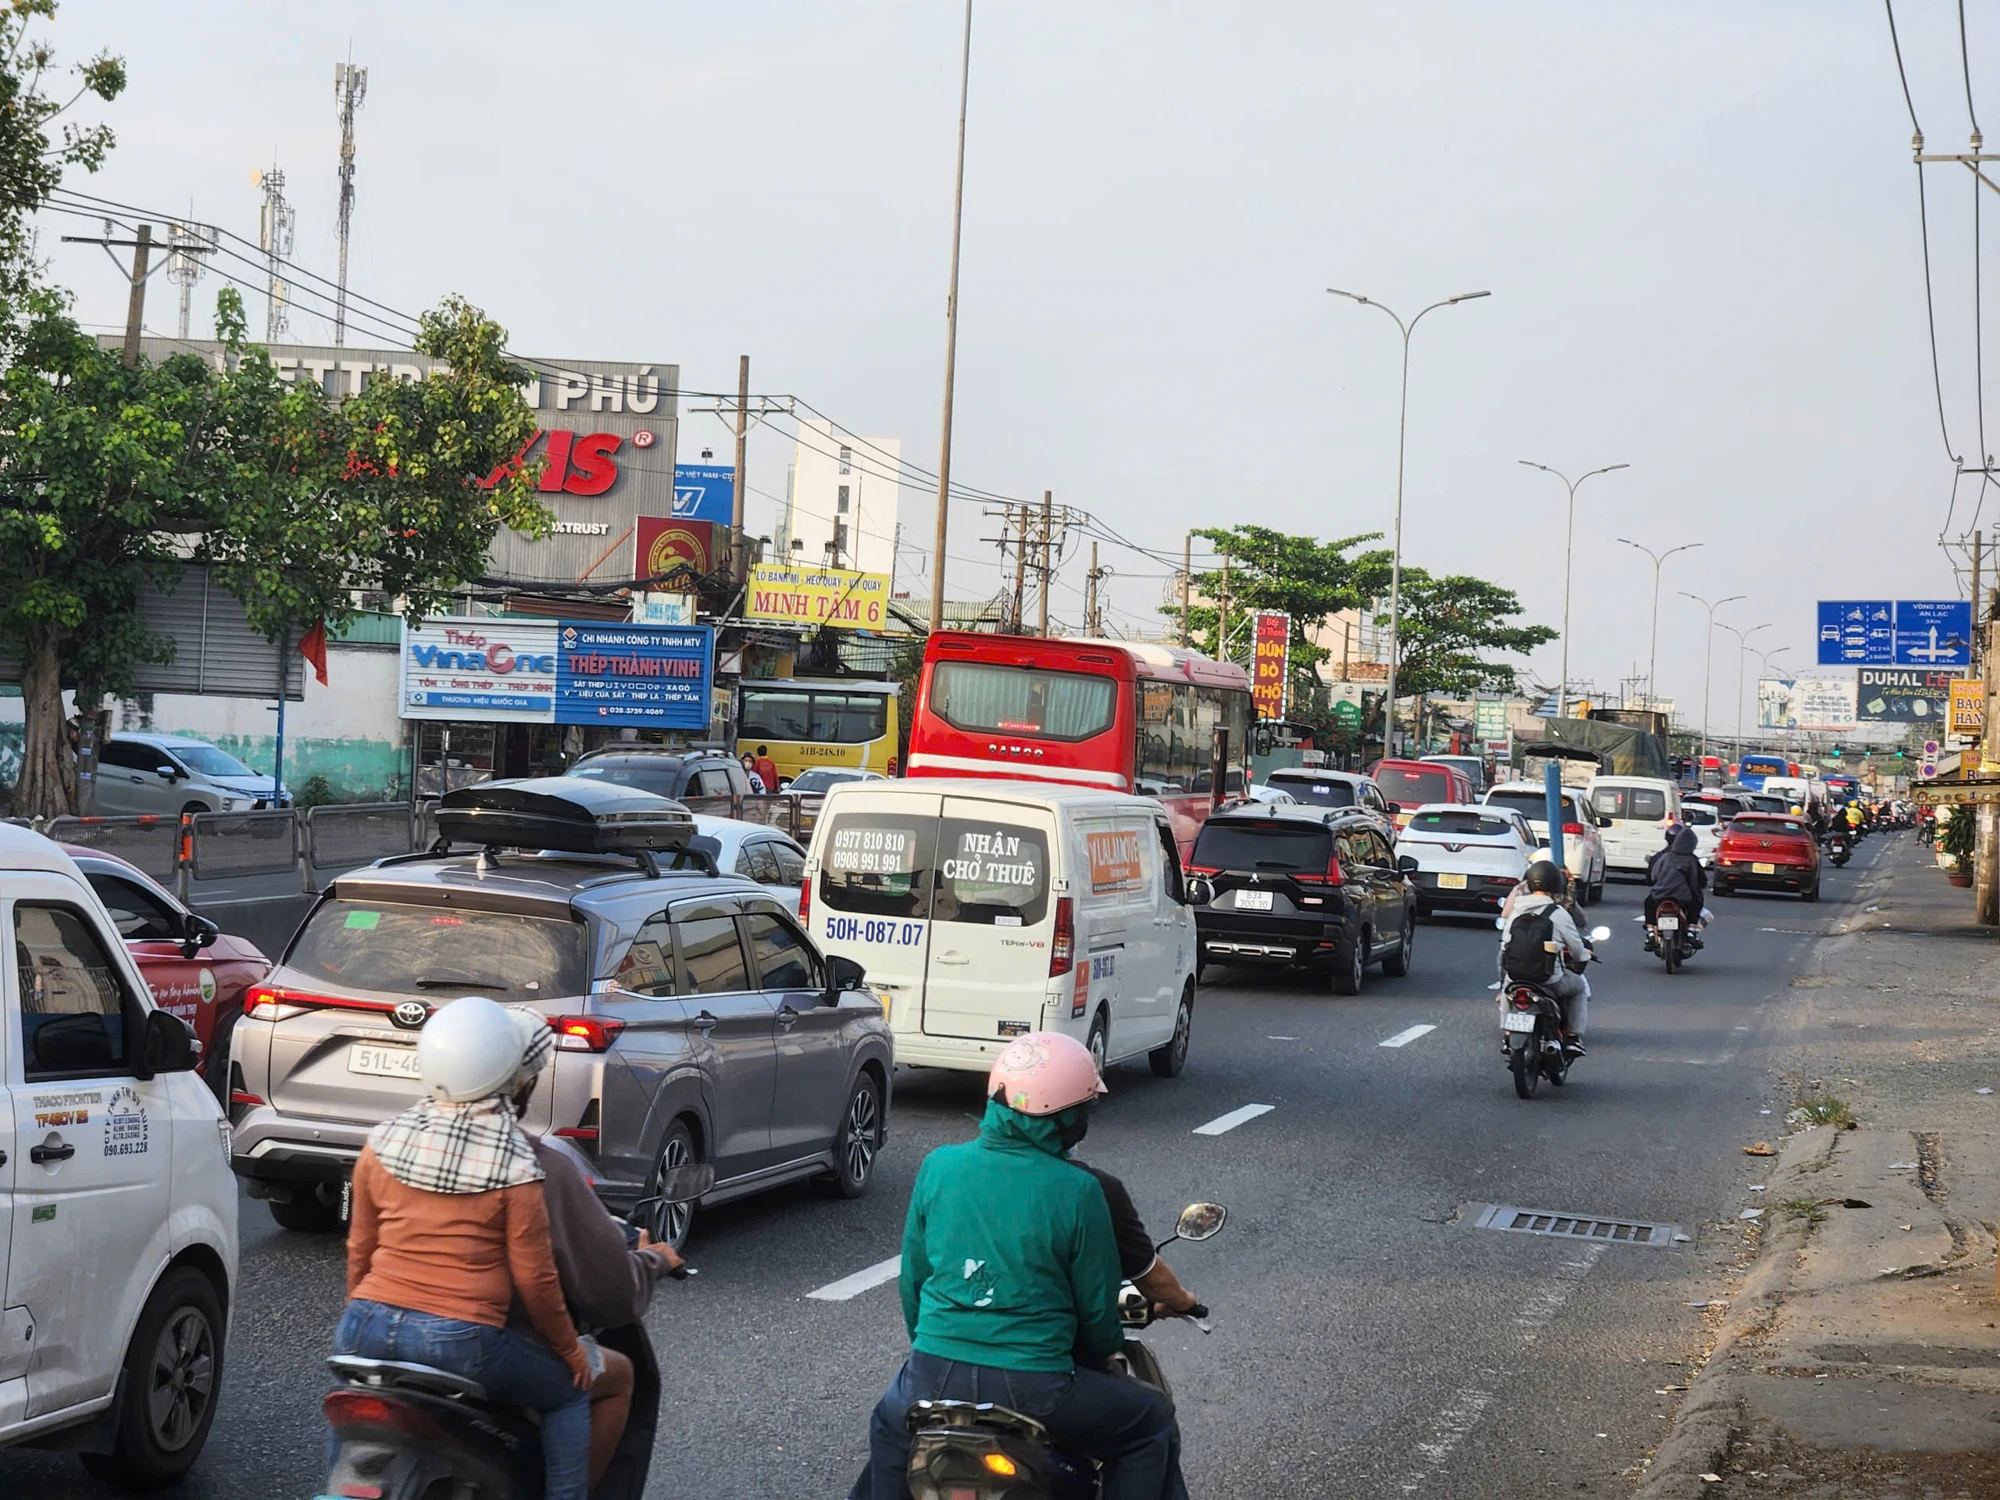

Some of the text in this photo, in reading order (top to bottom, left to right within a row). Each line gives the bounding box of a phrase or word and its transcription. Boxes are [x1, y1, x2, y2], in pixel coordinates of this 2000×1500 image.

[557, 366, 660, 414] PHÚ
[806, 573, 821, 585] HEO
[822, 574, 842, 588] QUAY
[863, 580, 883, 592] QUAY
[754, 591, 879, 623] MINH TÂM 6
[445, 629, 487, 650] Thép
[582, 633, 595, 643] CHI
[626, 634, 650, 646] CÔNG
[651, 637, 661, 646] TY
[662, 637, 682, 647] TNHH
[684, 638, 701, 647] MTV
[1257, 640, 1285, 657] BÚN
[569, 650, 608, 675] THÉP
[663, 659, 700, 678] VINH
[1259, 660, 1279, 677] BÒ
[1862, 671, 1922, 686] DUHAL
[1254, 682, 1283, 699] THỐ
[515, 698, 528, 706] GIA
[835, 830, 905, 852] 0977 810 810
[964, 831, 1020, 858] NHẬN
[834, 851, 901, 872] 0908 991 991
[943, 854, 1035, 885] CHỞ THUÊ
[826, 917, 924, 946] 50H-087.07
[104, 1142, 148, 1156] 090.693.228
[341, 1180, 352, 1221] Supreme
